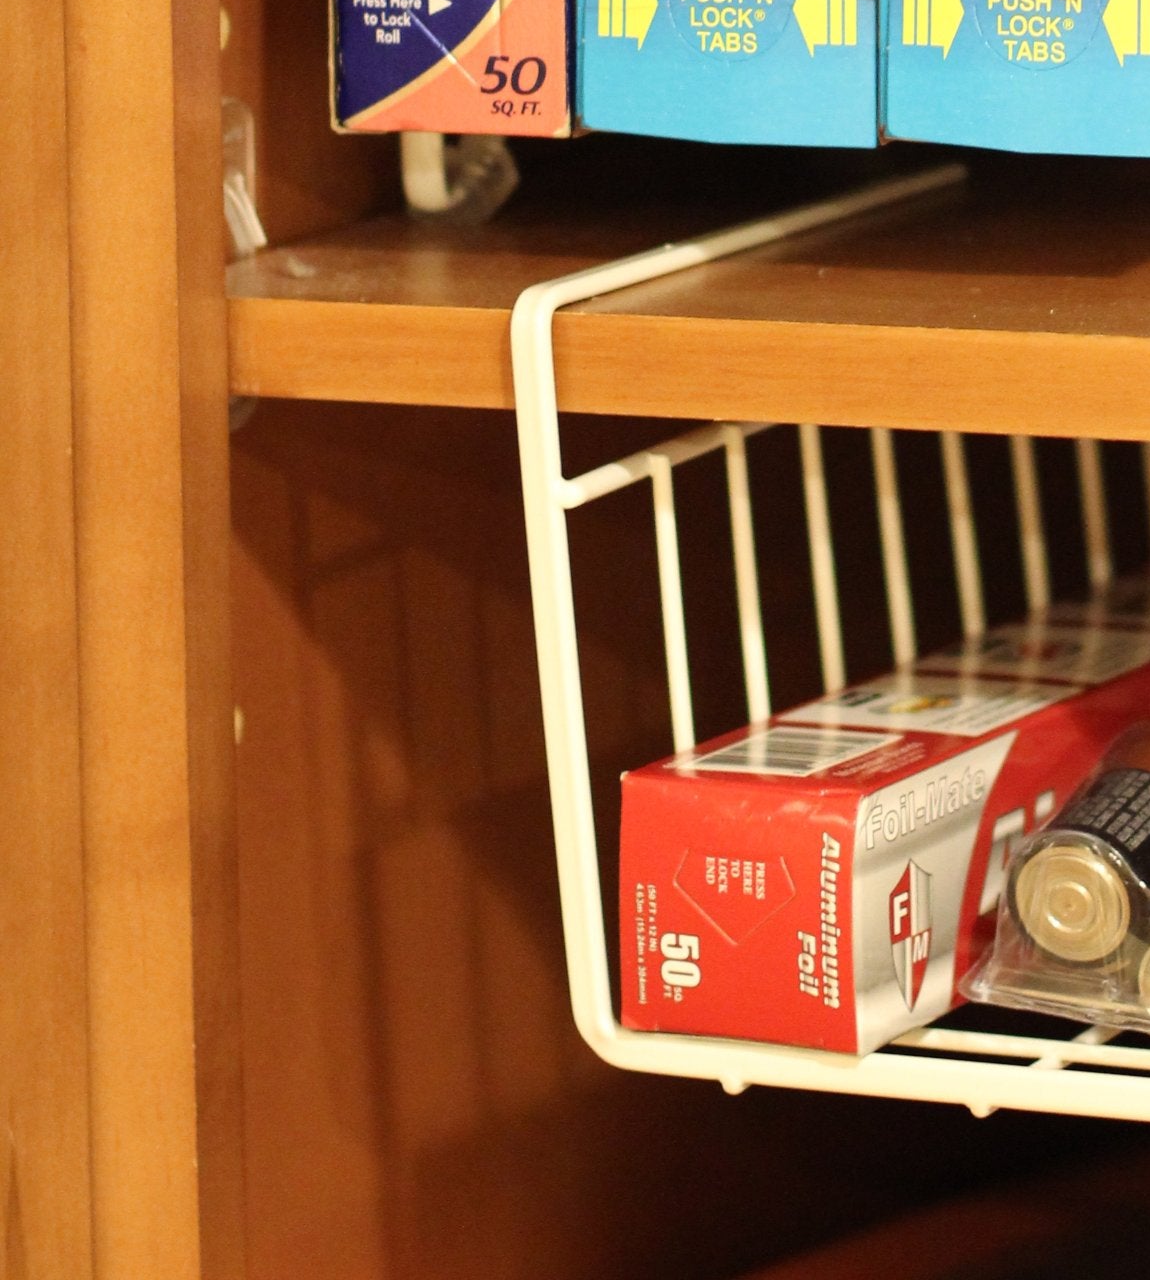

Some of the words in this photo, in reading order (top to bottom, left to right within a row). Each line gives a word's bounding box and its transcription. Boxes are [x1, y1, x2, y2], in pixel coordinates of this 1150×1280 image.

[363, 12, 378, 26] to
[380, 12, 412, 28] Lock
[375, 28, 401, 44] Roll
[697, 30, 758, 54] TABS
[1003, 40, 1066, 64] TABS
[480, 55, 547, 96] 50
[490, 99, 516, 116] SQ.
[520, 99, 542, 116] FT.
[866, 766, 986, 851] Foil-Mate
[705, 855, 716, 886] END
[717, 856, 728, 894] LOCK
[730, 859, 740, 879] TO
[742, 860, 753, 896] HERE
[755, 861, 765, 900] PRESS
[648, 901, 657, 915] FT
[820, 831, 841, 1009] Aluminum
[892, 891, 909, 937] F
[648, 925, 657, 936] 12
[659, 931, 701, 988] 50
[912, 931, 929, 964] M
[797, 930, 819, 997] Foil
[663, 985, 673, 999] FT
[673, 986, 683, 1003] SQ
